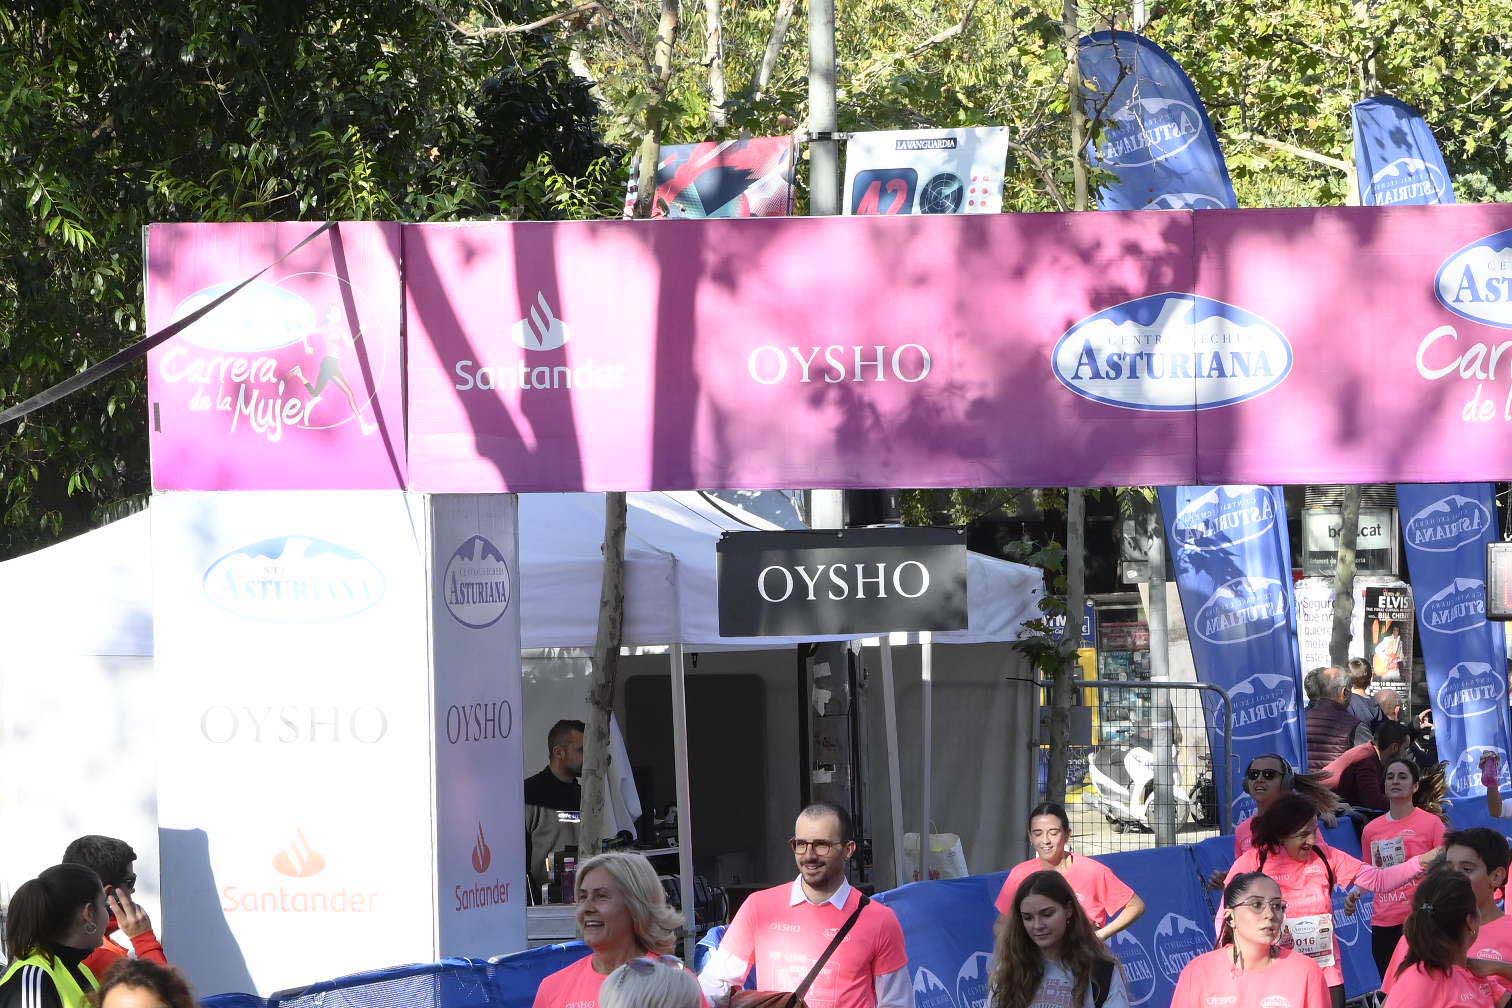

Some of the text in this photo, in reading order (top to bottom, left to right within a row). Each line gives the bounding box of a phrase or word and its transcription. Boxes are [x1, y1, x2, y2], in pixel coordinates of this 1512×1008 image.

[159, 343, 280, 386] Carrera
[455, 359, 626, 391] Santander
[748, 343, 932, 385] OYSHO
[1070, 338, 1275, 381] ASTURIANA
[229, 379, 324, 442] Mujer
[1462, 384, 1497, 423] de
[449, 573, 507, 606] ASTURIANA
[757, 557, 931, 606] OYSHO
[1378, 595, 1409, 609] ELVIS
[199, 704, 389, 745] OYSHO
[445, 700, 513, 745] OYSHO
[222, 885, 378, 913] Santander
[454, 880, 510, 912] Santander
[1295, 936, 1315, 947] 016
